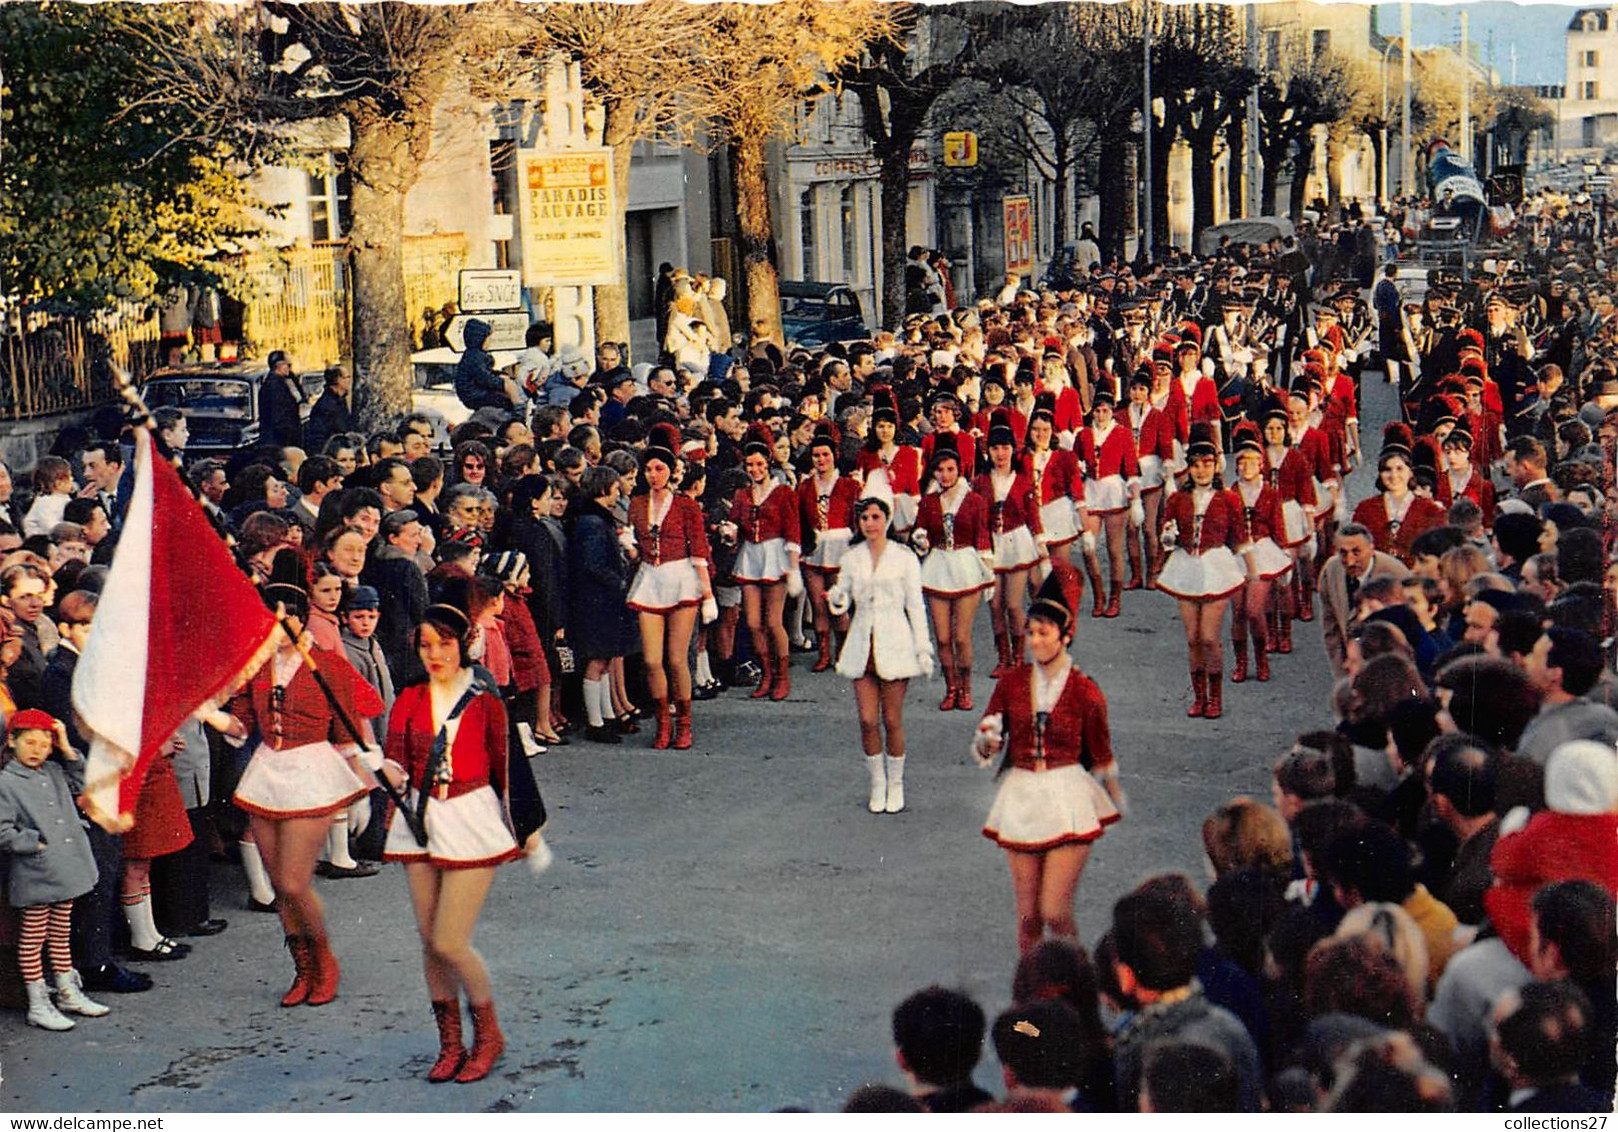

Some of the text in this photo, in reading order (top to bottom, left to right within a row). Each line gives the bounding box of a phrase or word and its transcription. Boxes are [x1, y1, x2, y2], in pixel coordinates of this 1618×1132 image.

[529, 188, 607, 203] PARADIS
[530, 203, 608, 219] SAUVAGE
[486, 284, 517, 302] SNCF
